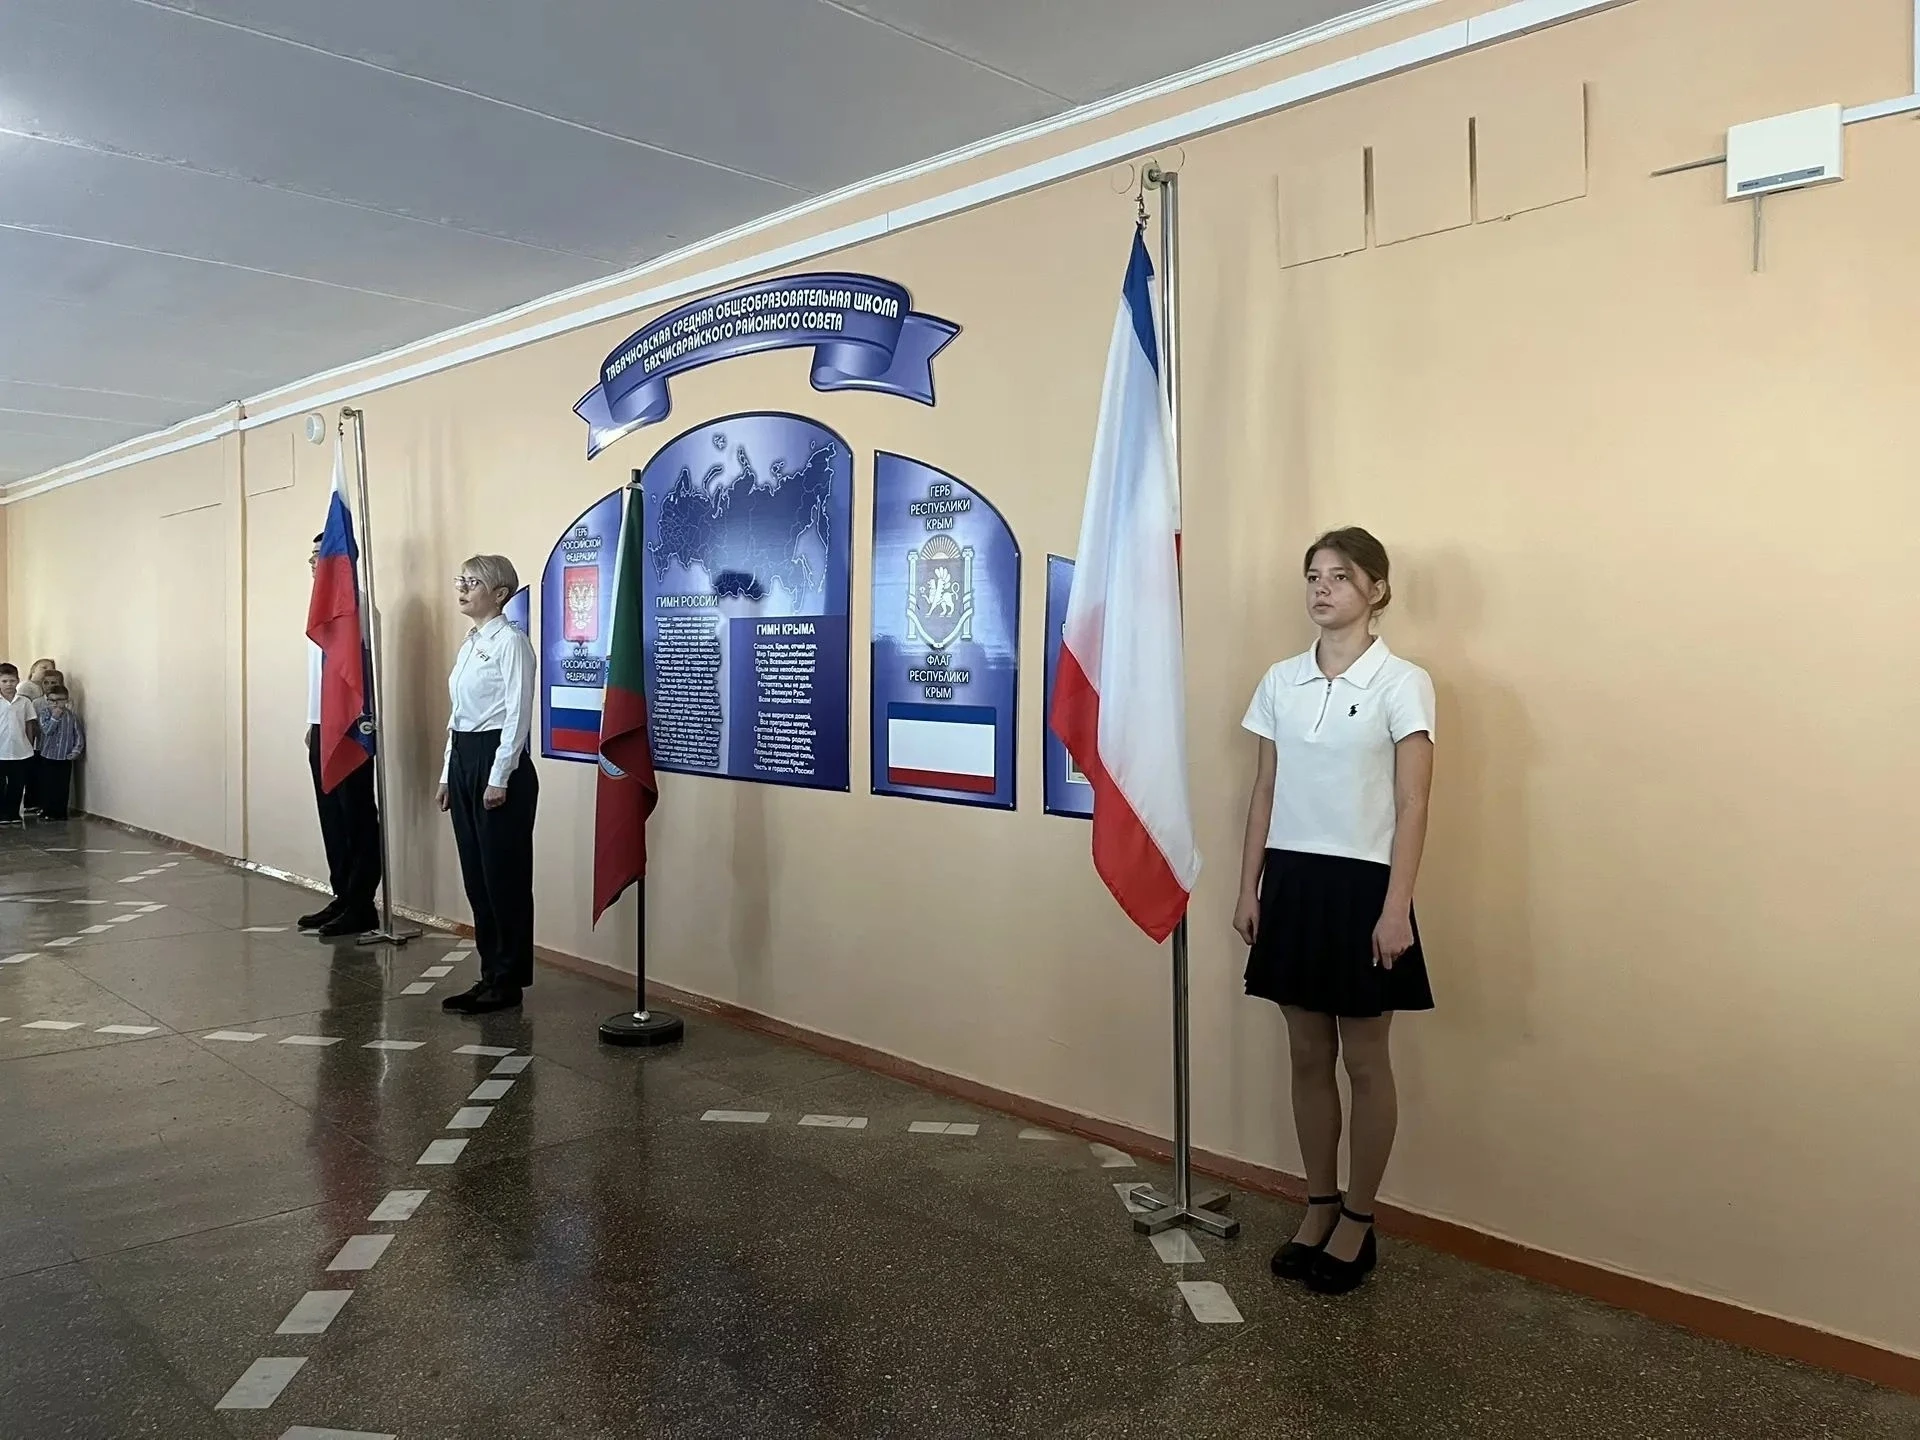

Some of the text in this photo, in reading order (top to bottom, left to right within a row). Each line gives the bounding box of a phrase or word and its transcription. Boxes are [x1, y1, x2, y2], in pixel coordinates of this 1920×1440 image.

[605, 289, 899, 381] ТАБАЧНОВСКАЯ СРЕДНЯЯ ОБЩЕОБРАЗОВАТЕЛЬНАЯ ШКОЛА
[643, 311, 843, 373] БАХЧИСАРАЙСКОГО РАЙОННОГО СОВЕТА
[930, 484, 951, 497] ГЕРБ
[910, 499, 971, 515] РЕСПУБЛИКИ
[926, 517, 953, 530] КРЫМ
[656, 595, 718, 608] ГИМН РОССИИ
[756, 623, 815, 635] ГИМН КРЫМА
[562, 659, 601, 669] РОССИЙСКОЙ
[927, 654, 952, 665] ФЛАГ
[566, 671, 597, 682] ФЕДЕРАЦИИ
[909, 670, 970, 683] РЕСПУБЛИКИ
[925, 687, 952, 699] КРЫМ
